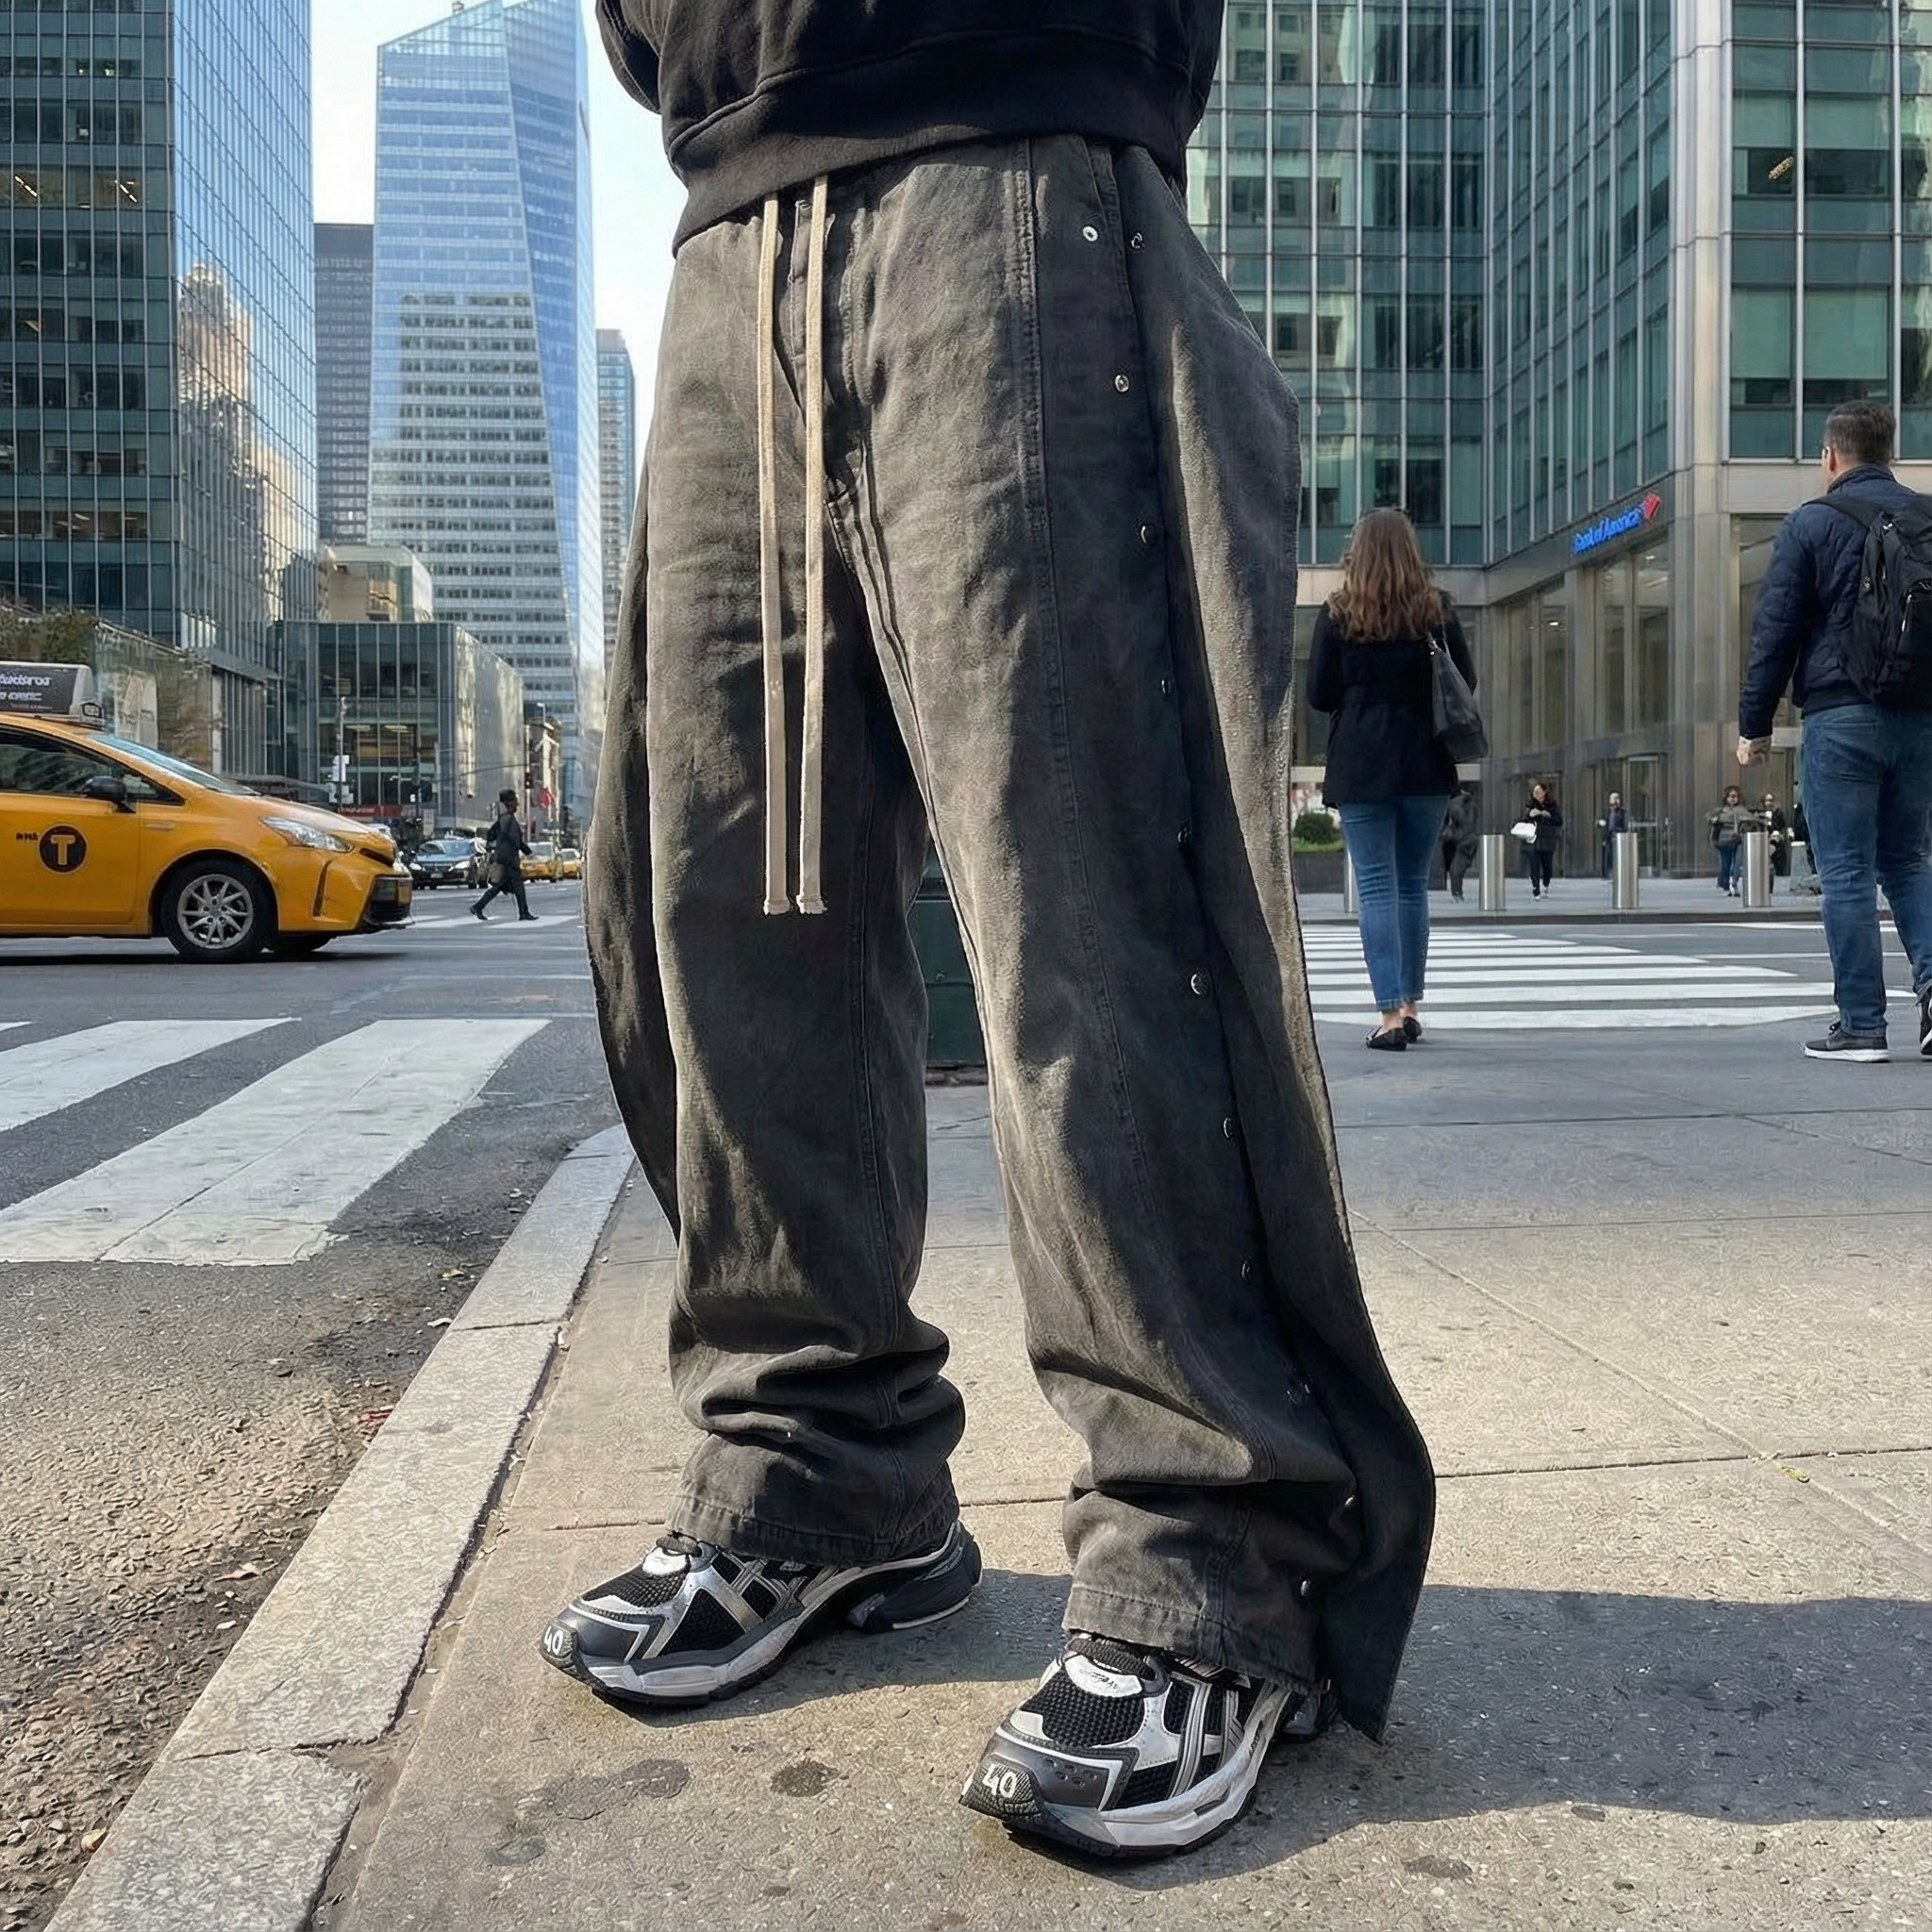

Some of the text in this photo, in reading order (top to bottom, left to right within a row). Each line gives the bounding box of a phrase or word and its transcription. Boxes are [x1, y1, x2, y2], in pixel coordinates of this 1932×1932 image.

[50, 834, 76, 866] T
[543, 1625, 564, 1656] 40
[982, 1763, 1017, 1799] 40
